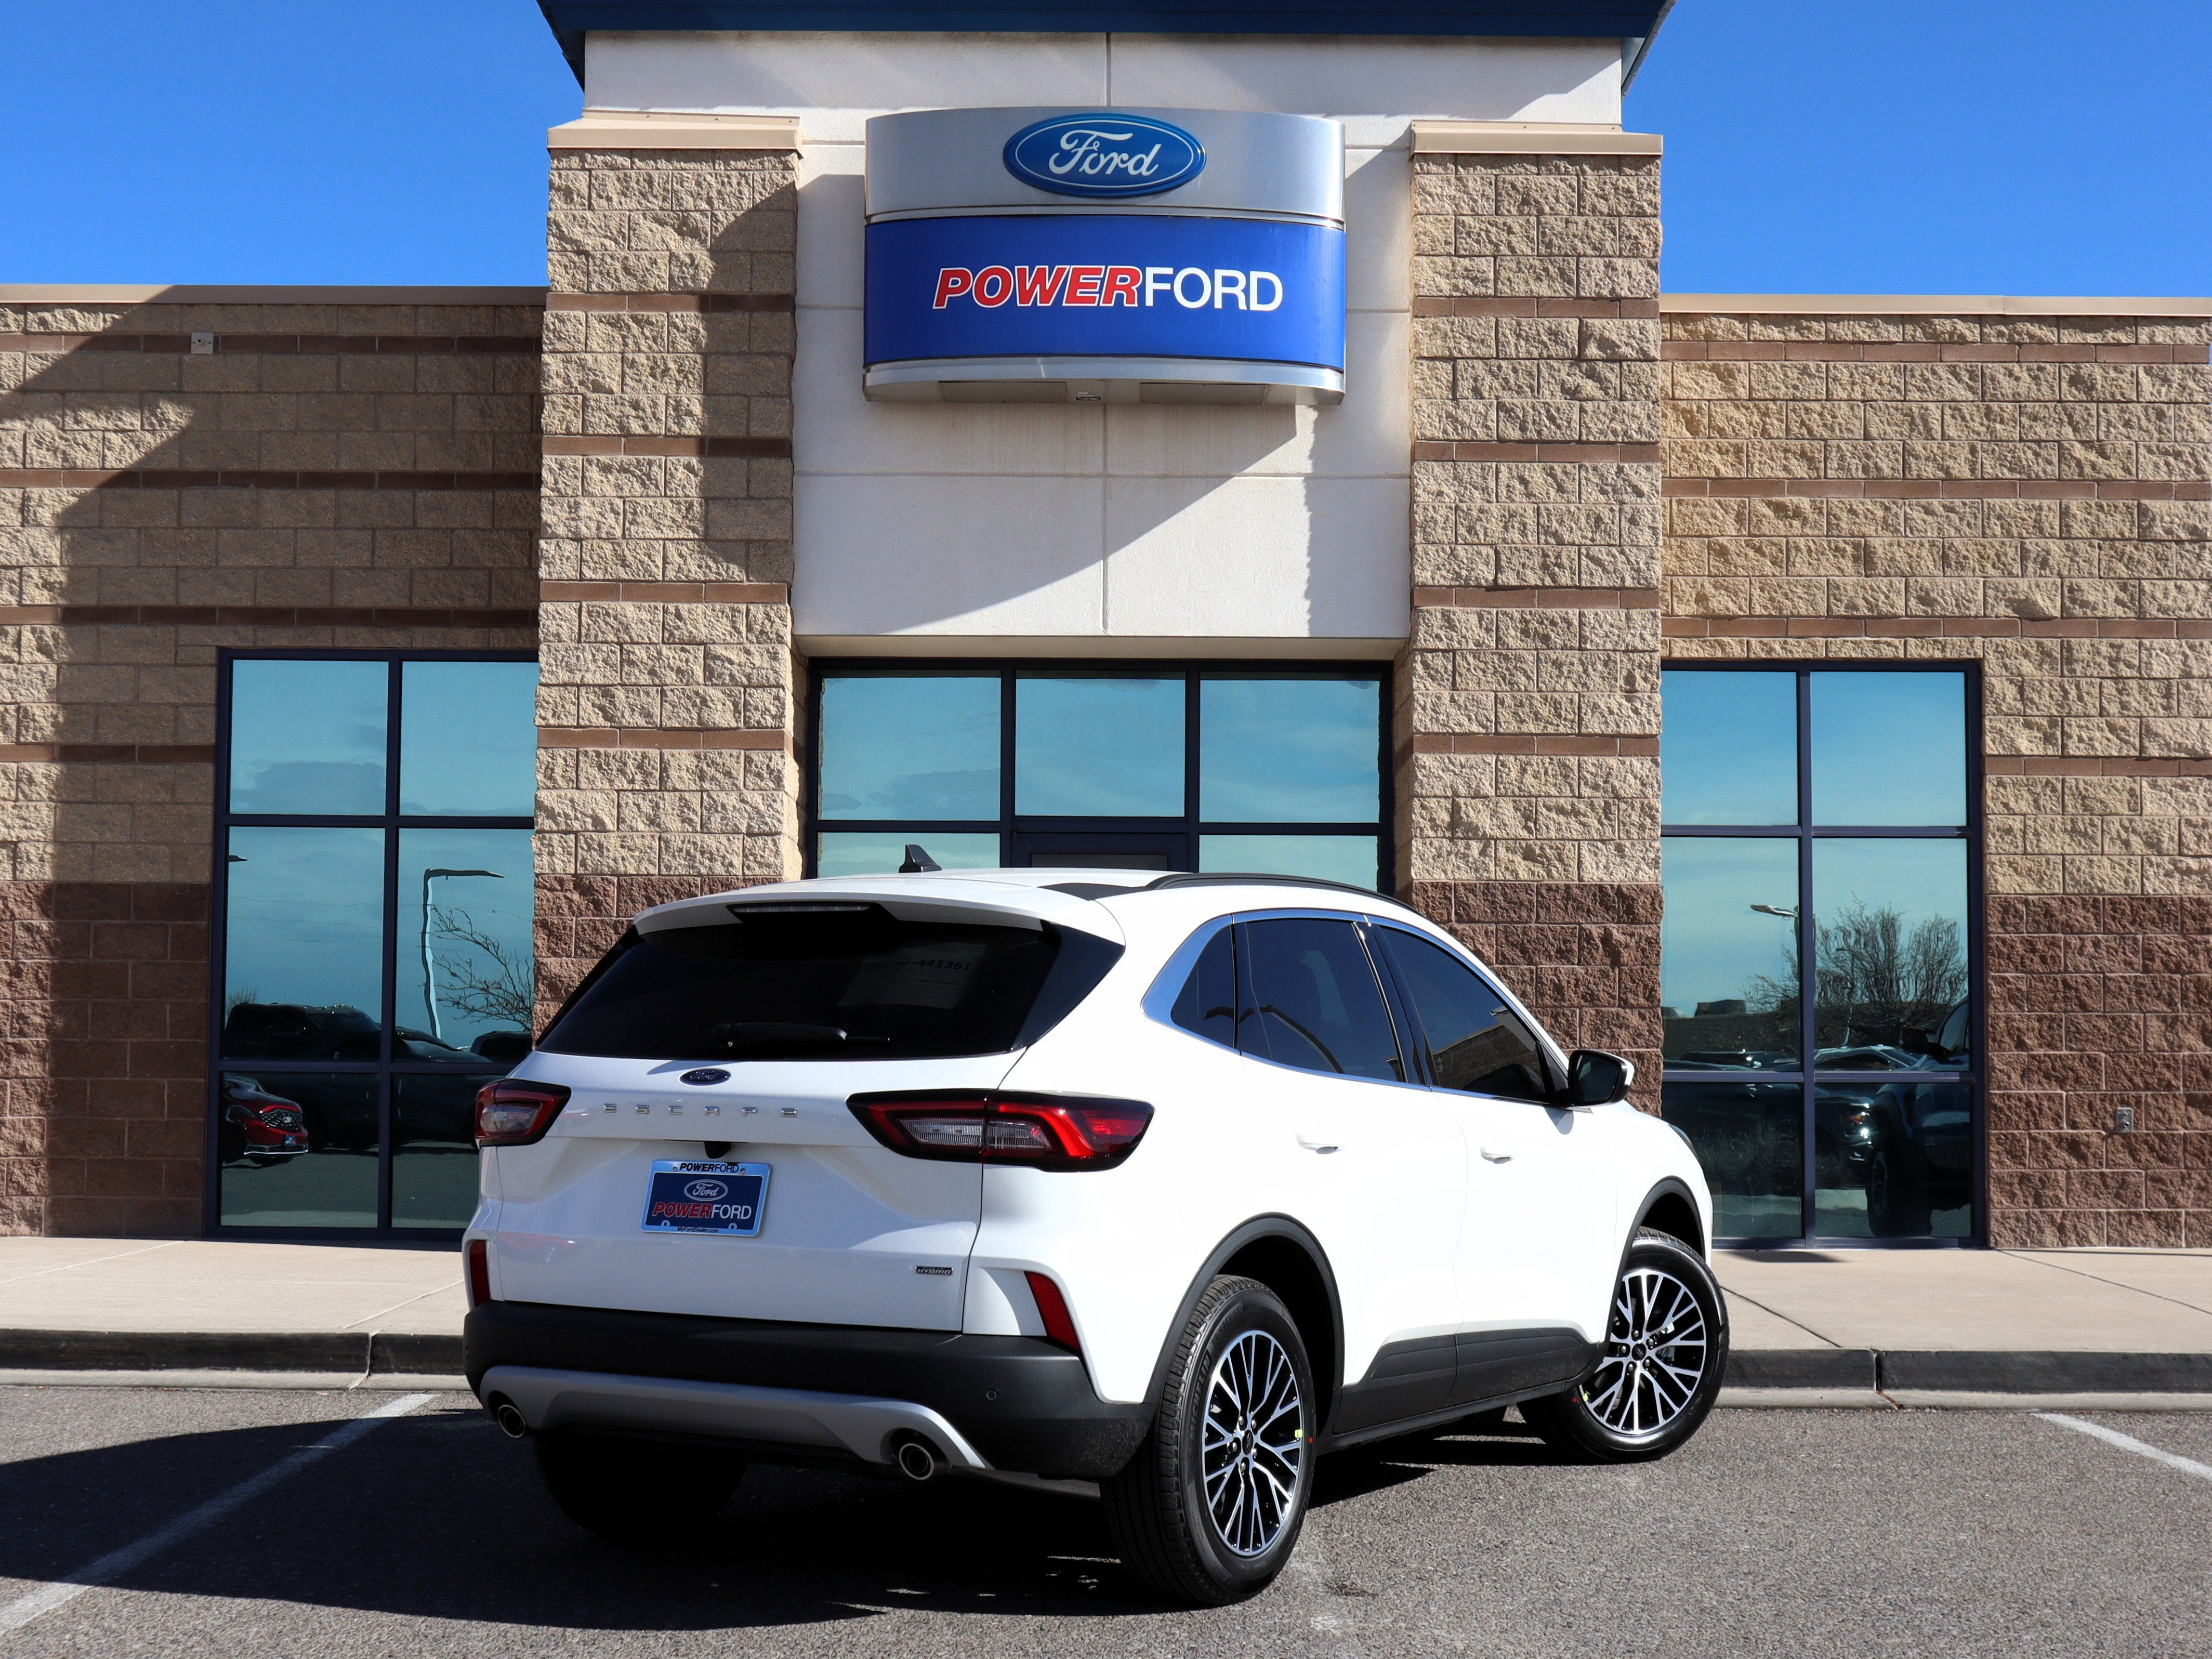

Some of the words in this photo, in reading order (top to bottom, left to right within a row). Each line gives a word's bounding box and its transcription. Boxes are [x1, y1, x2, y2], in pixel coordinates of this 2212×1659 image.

[1048, 129, 1162, 177] Ford
[602, 1103, 798, 1117] ESCAPE
[692, 1182, 720, 1196] Ford
[1189, 1352, 1212, 1441] MICHELIN
